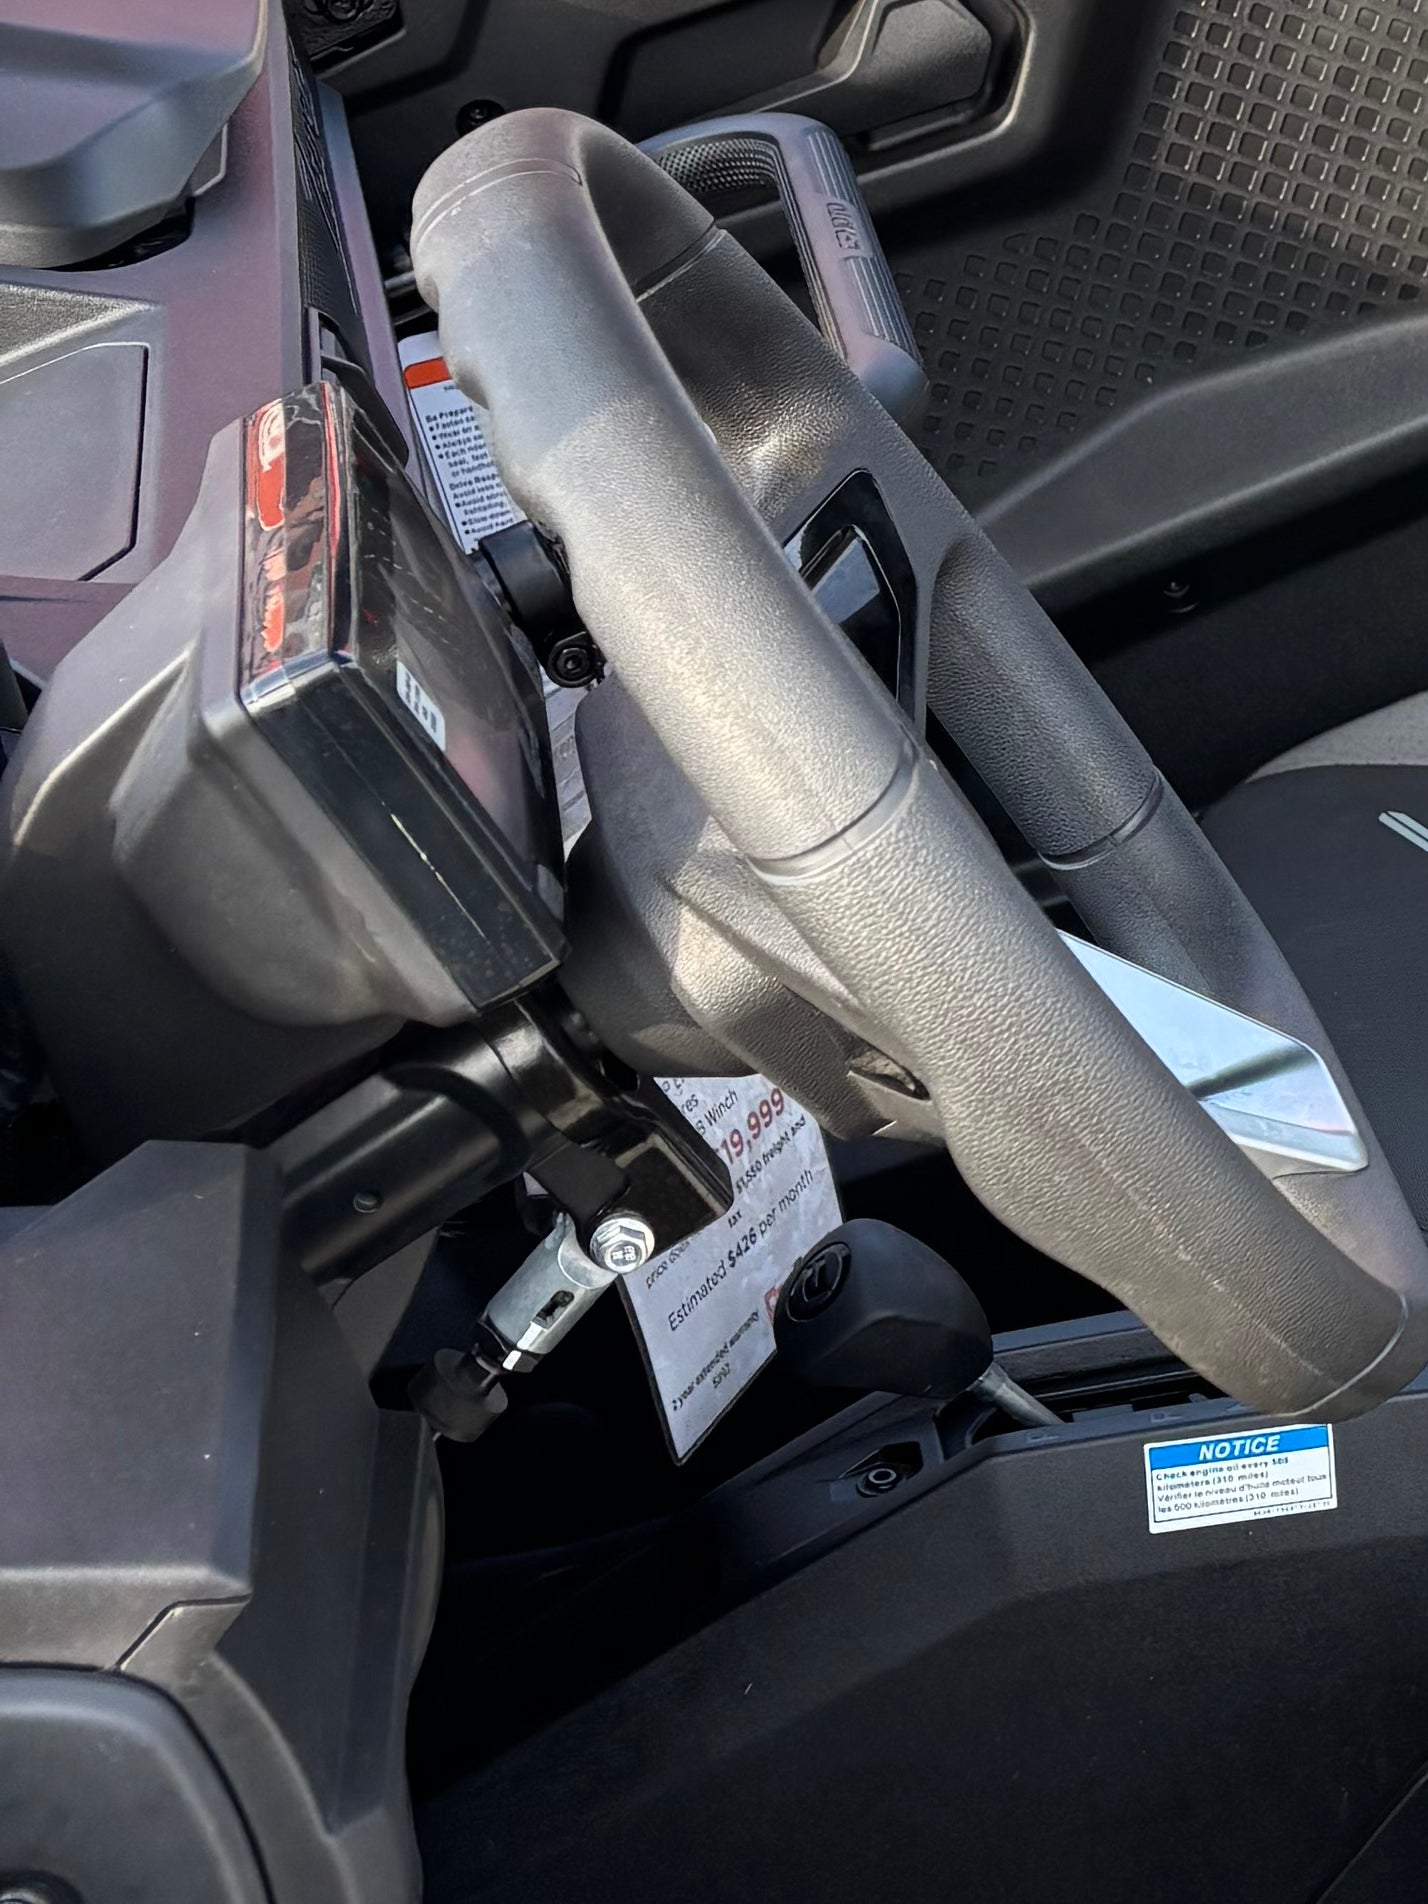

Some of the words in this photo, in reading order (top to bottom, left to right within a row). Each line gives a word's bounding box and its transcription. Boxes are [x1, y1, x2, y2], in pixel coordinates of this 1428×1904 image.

[439, 406, 474, 420] Prepare
[704, 1088, 739, 1127] Winch
[715, 1088, 784, 1164] 19,999
[668, 1259, 727, 1331] Estimated
[728, 1227, 757, 1268] $426
[758, 1207, 777, 1239] per
[778, 1169, 813, 1213] month
[1199, 1434, 1281, 1462] NOTICE
[1155, 1470, 1187, 1481] Check
[1241, 1459, 1269, 1471] every
